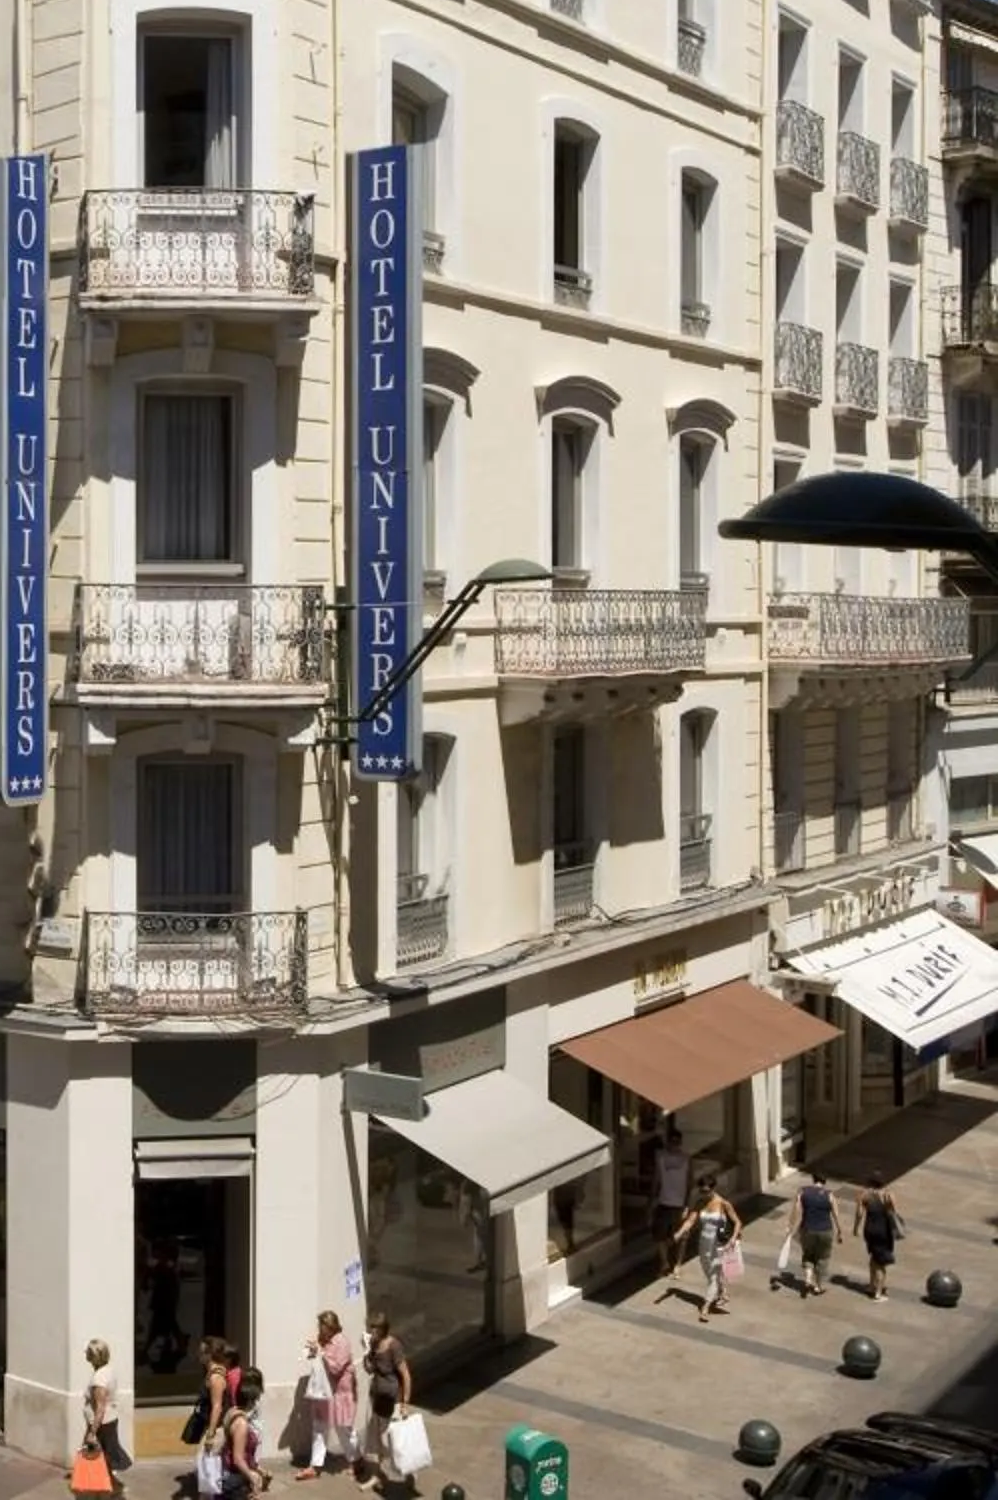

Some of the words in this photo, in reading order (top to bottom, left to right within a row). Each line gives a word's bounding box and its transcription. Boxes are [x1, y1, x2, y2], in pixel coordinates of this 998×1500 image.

[15, 159, 38, 398] HOTEL
[369, 160, 396, 392] HOTEL
[14, 433, 39, 757] UNIVERS
[367, 424, 397, 737] UNIVERS
